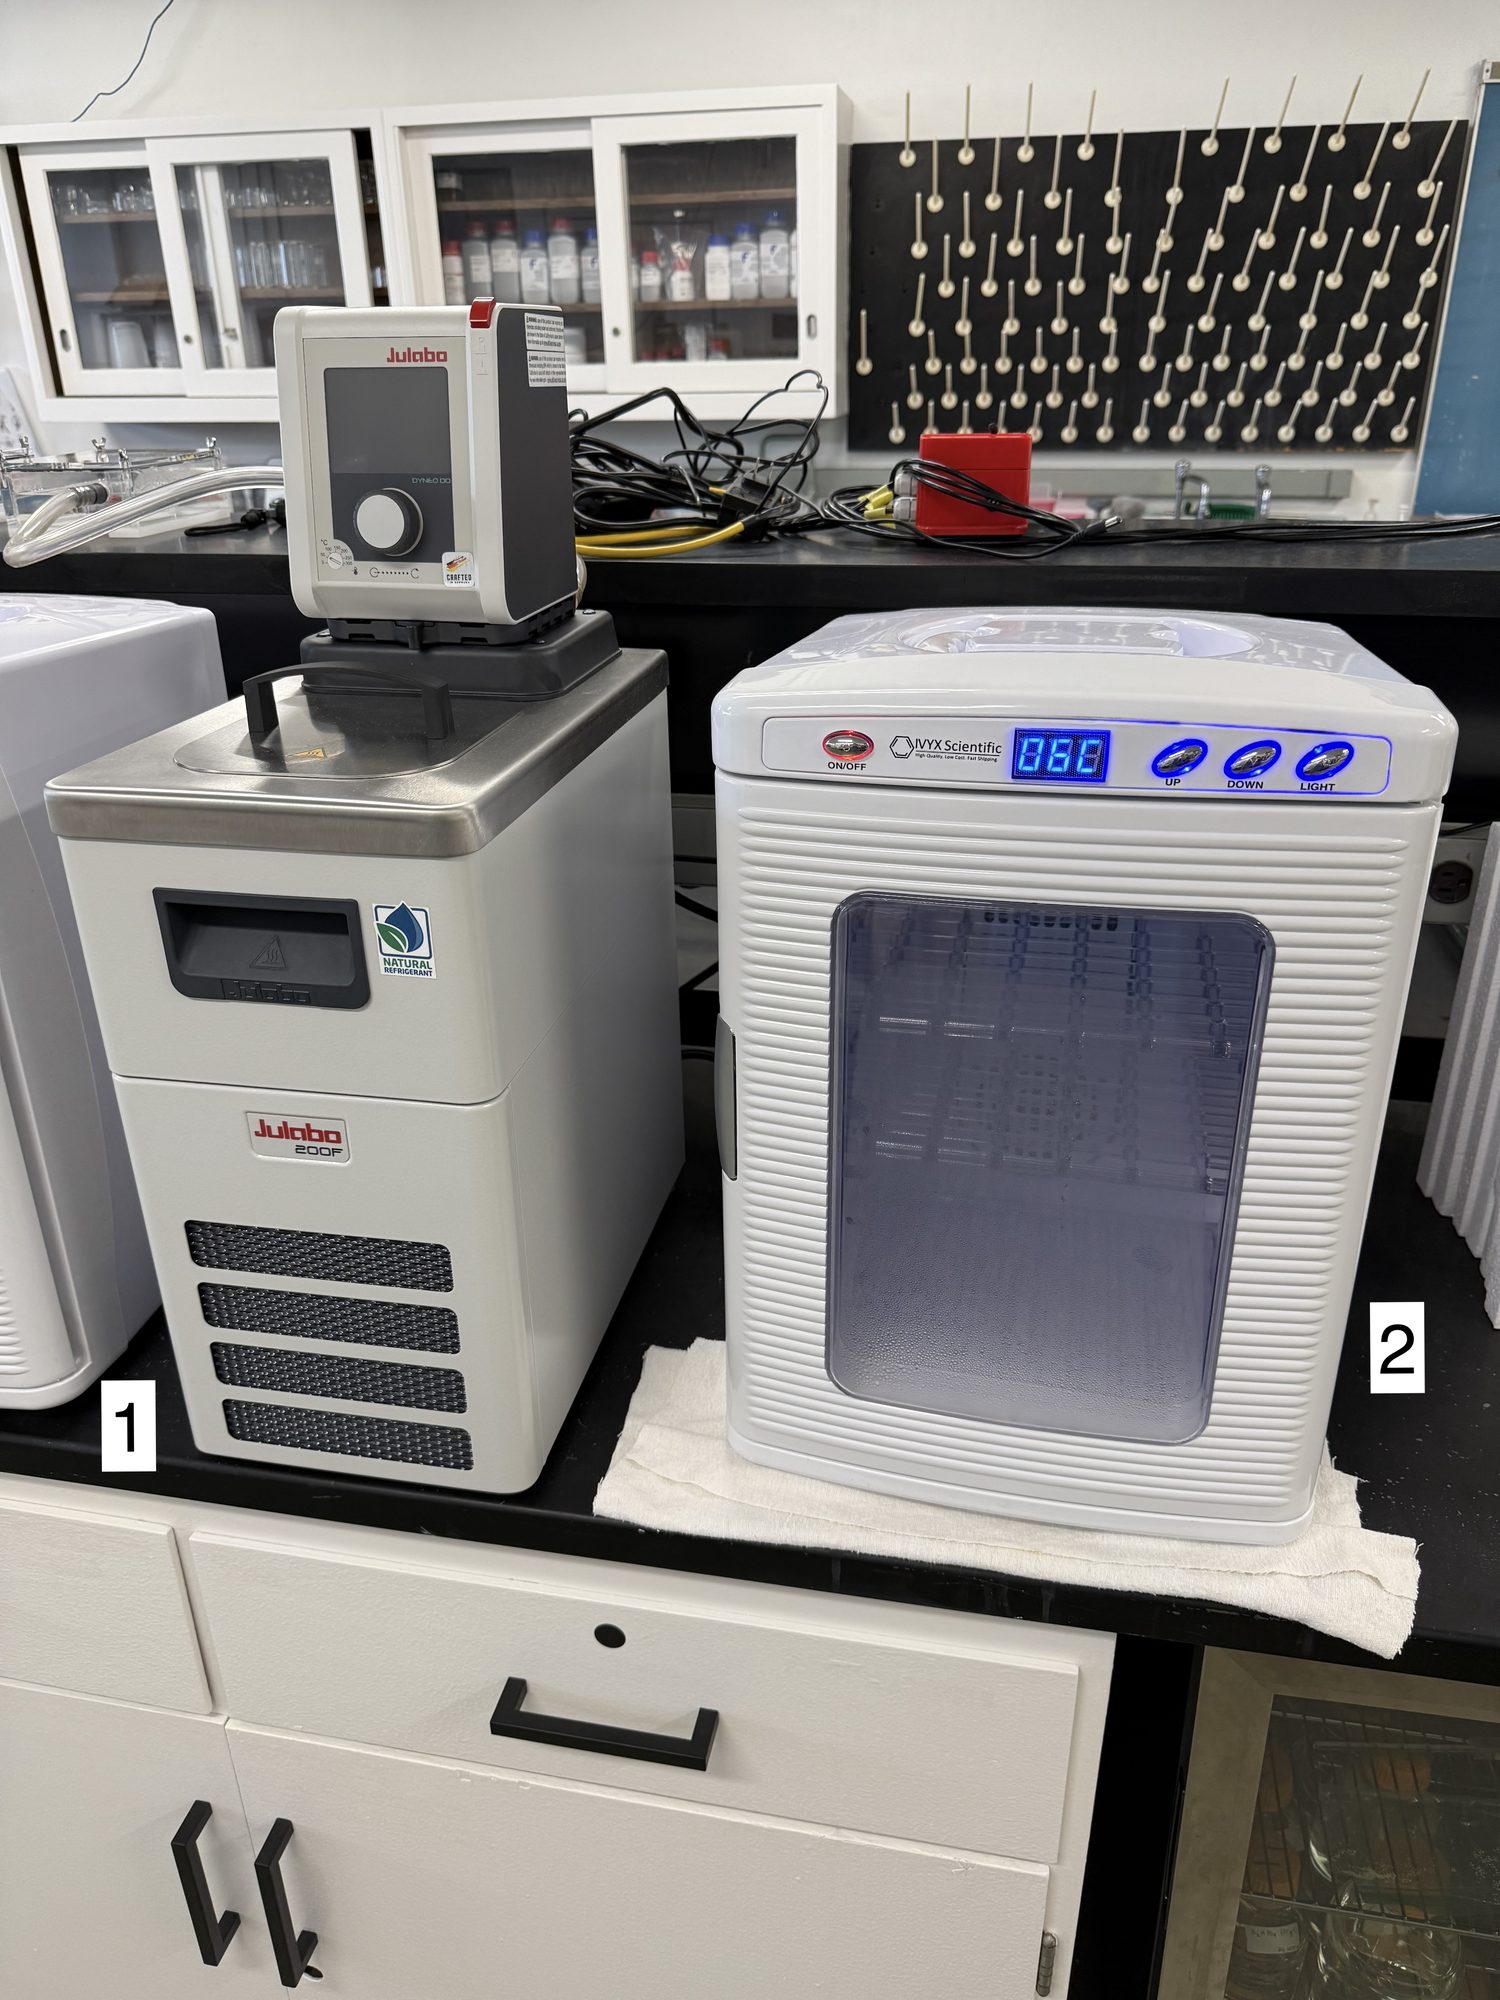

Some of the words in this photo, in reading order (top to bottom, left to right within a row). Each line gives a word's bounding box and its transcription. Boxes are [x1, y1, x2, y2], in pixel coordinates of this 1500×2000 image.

[386, 347, 448, 362] Julabo
[915, 738, 942, 750] IVYX
[944, 740, 1002, 754] Scientific
[828, 761, 867, 771] ON/OFF
[1165, 778, 1181, 787] UP
[1227, 780, 1264, 789] DOWN
[1300, 782, 1336, 791] LIGHT
[383, 957, 433, 970] NATURAL
[384, 967, 433, 977] REFRIGERANT
[254, 1119, 342, 1144] Julabo
[295, 1144, 344, 1157] 200F
